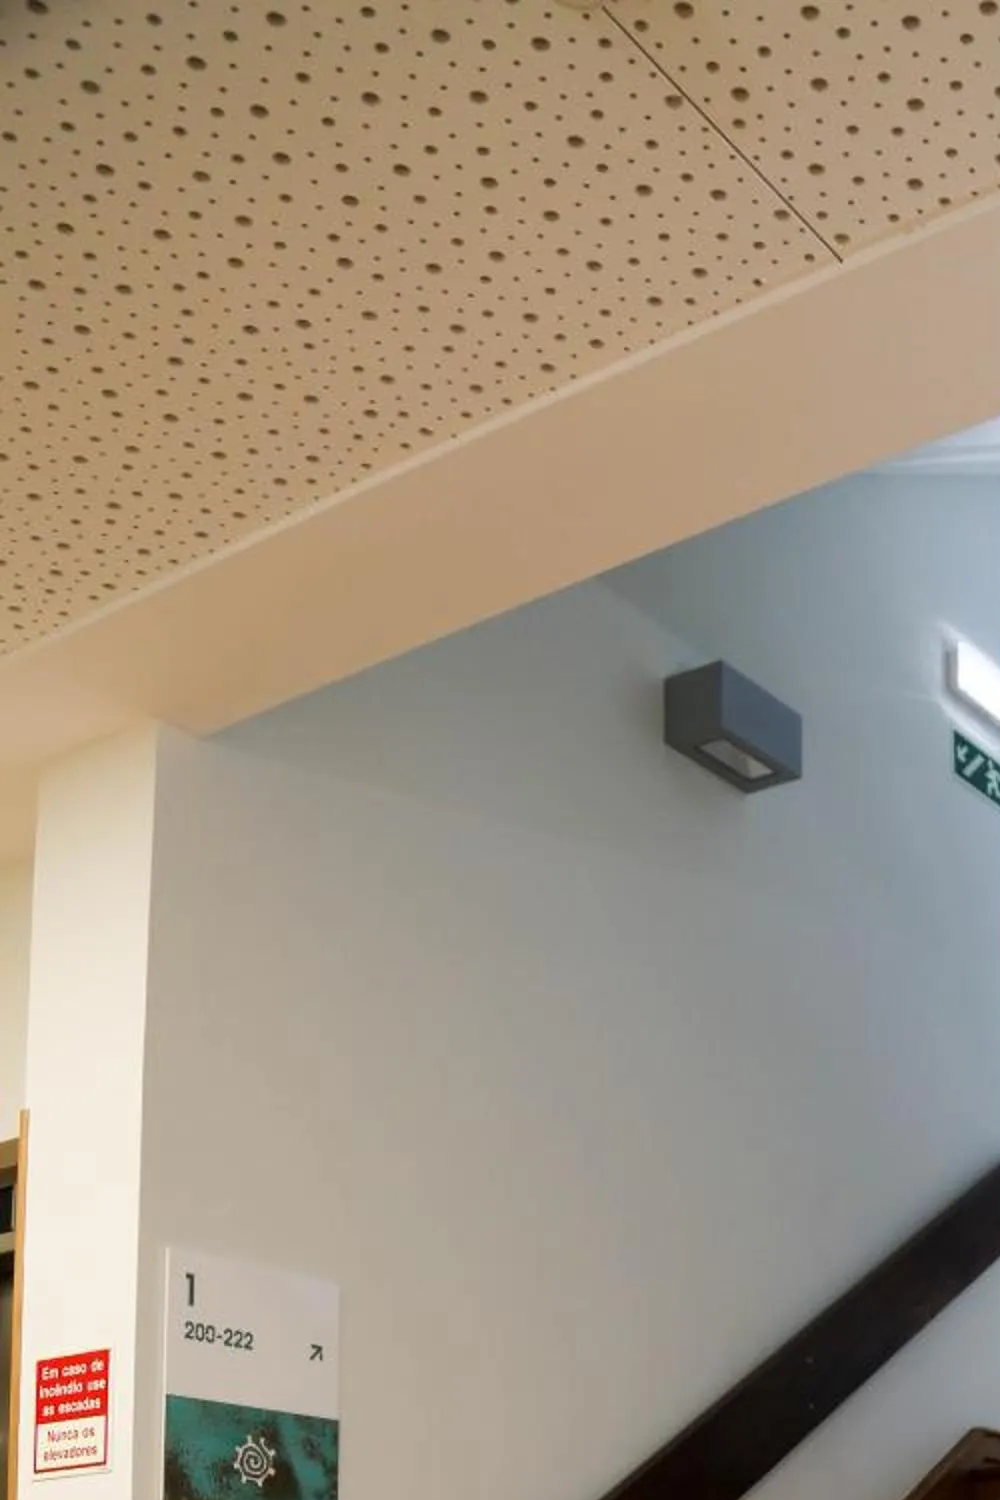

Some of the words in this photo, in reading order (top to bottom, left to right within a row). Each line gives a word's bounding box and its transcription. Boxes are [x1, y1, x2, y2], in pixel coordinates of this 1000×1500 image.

[185, 1272, 195, 1306] 1
[184, 1321, 254, 1350] 200-222
[41, 1367, 59, 1380] Em
[62, 1363, 87, 1377] caso
[91, 1359, 104, 1372] de
[87, 1379, 106, 1391] use
[42, 1405, 55, 1416] as
[58, 1397, 100, 1414] escadas
[47, 1428, 79, 1442] Nunca
[82, 1427, 95, 1439] os
[43, 1445, 97, 1461] elevadores
